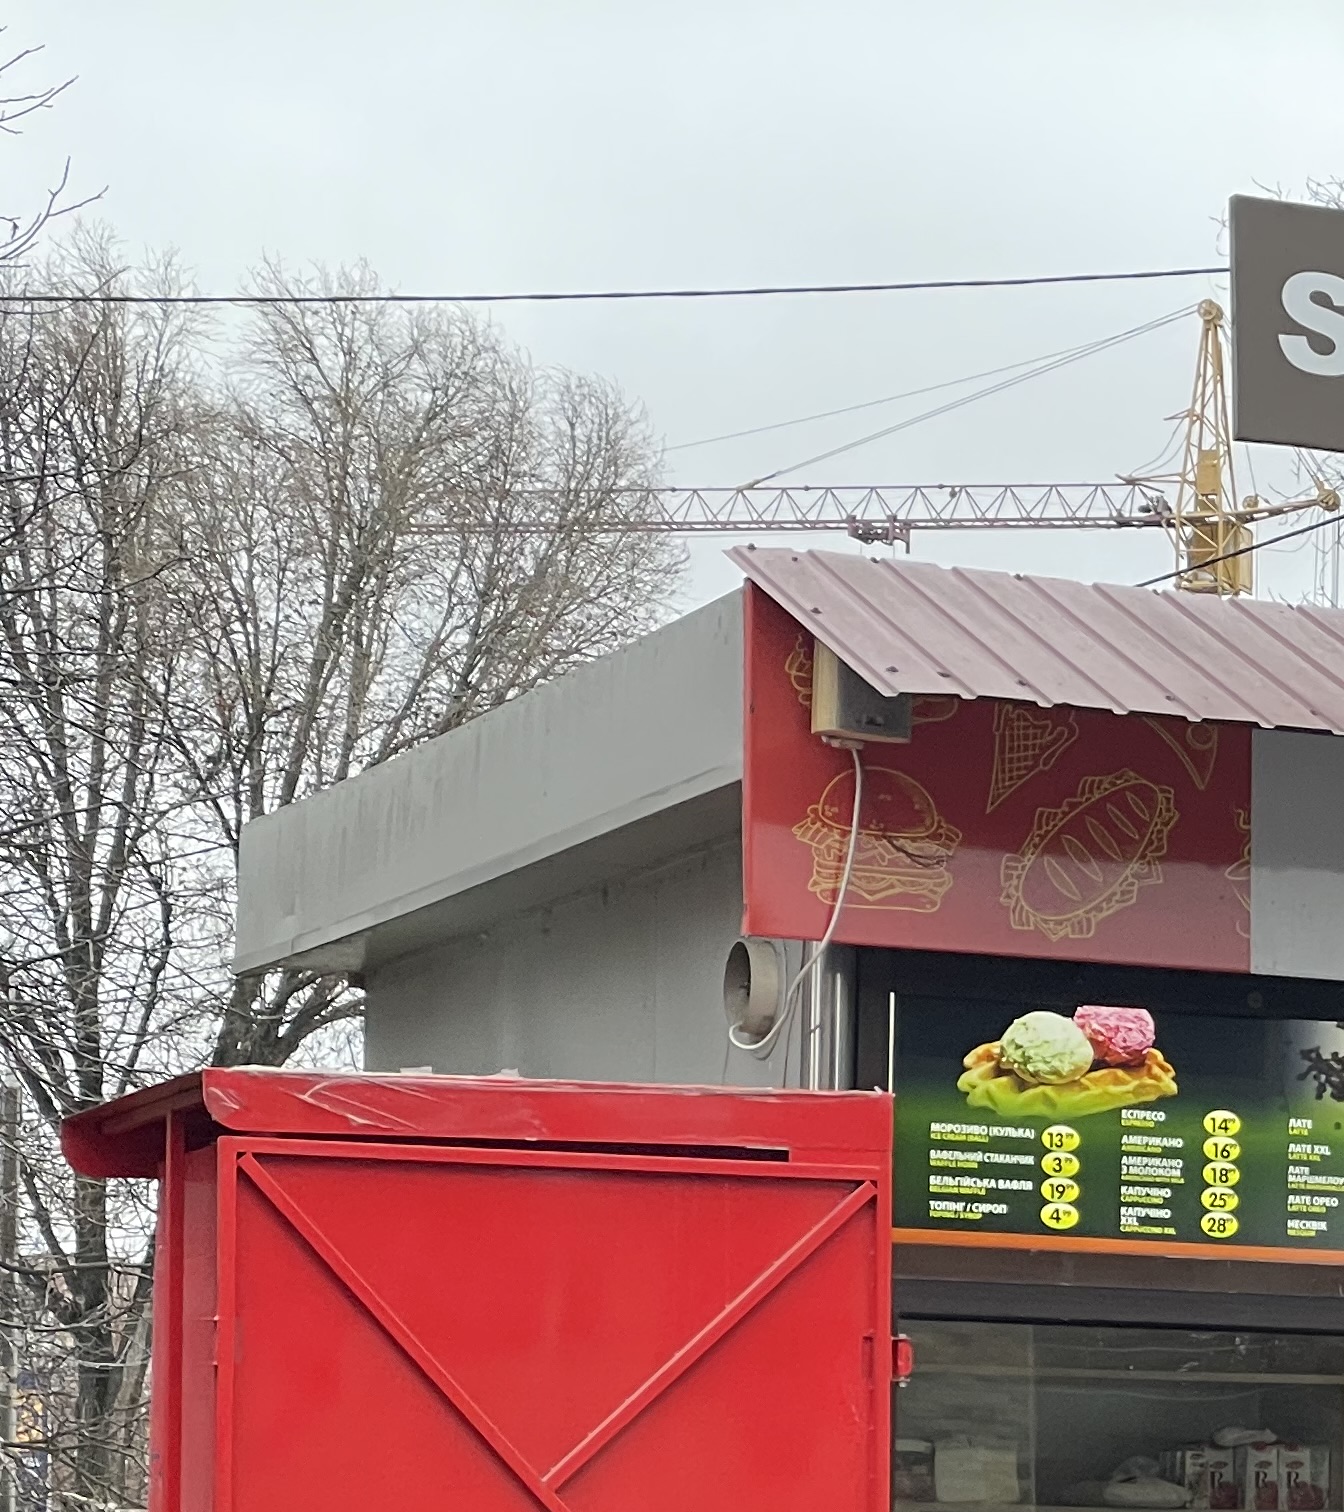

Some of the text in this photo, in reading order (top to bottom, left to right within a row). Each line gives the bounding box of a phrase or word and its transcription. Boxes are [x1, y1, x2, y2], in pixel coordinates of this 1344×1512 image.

[1121, 1109, 1166, 1121] ЕСПРЕСО
[931, 1123, 987, 1135] МОРОЗИВО
[1289, 1119, 1312, 1129] ЛАТЕ
[1121, 1135, 1183, 1148] АМЕРИКАНО
[1288, 1143, 1331, 1155] ЛАТЕ XXL
[1121, 1156, 1183, 1168] АМЕРИКАНО
[1129, 1166, 1181, 1177] МОЛОКОМ
[1288, 1166, 1310, 1175] ЛАТЕ
[998, 1180, 1033, 1190] ВАФЛЯ
[1121, 1186, 1172, 1198] КАПУЧІНО
[1288, 1195, 1338, 1207] ЛАТЕ ОРЕО
[929, 1201, 1007, 1214] ТОПІНГ СИРОП
[1121, 1206, 1171, 1218] КАПУЧІНО
